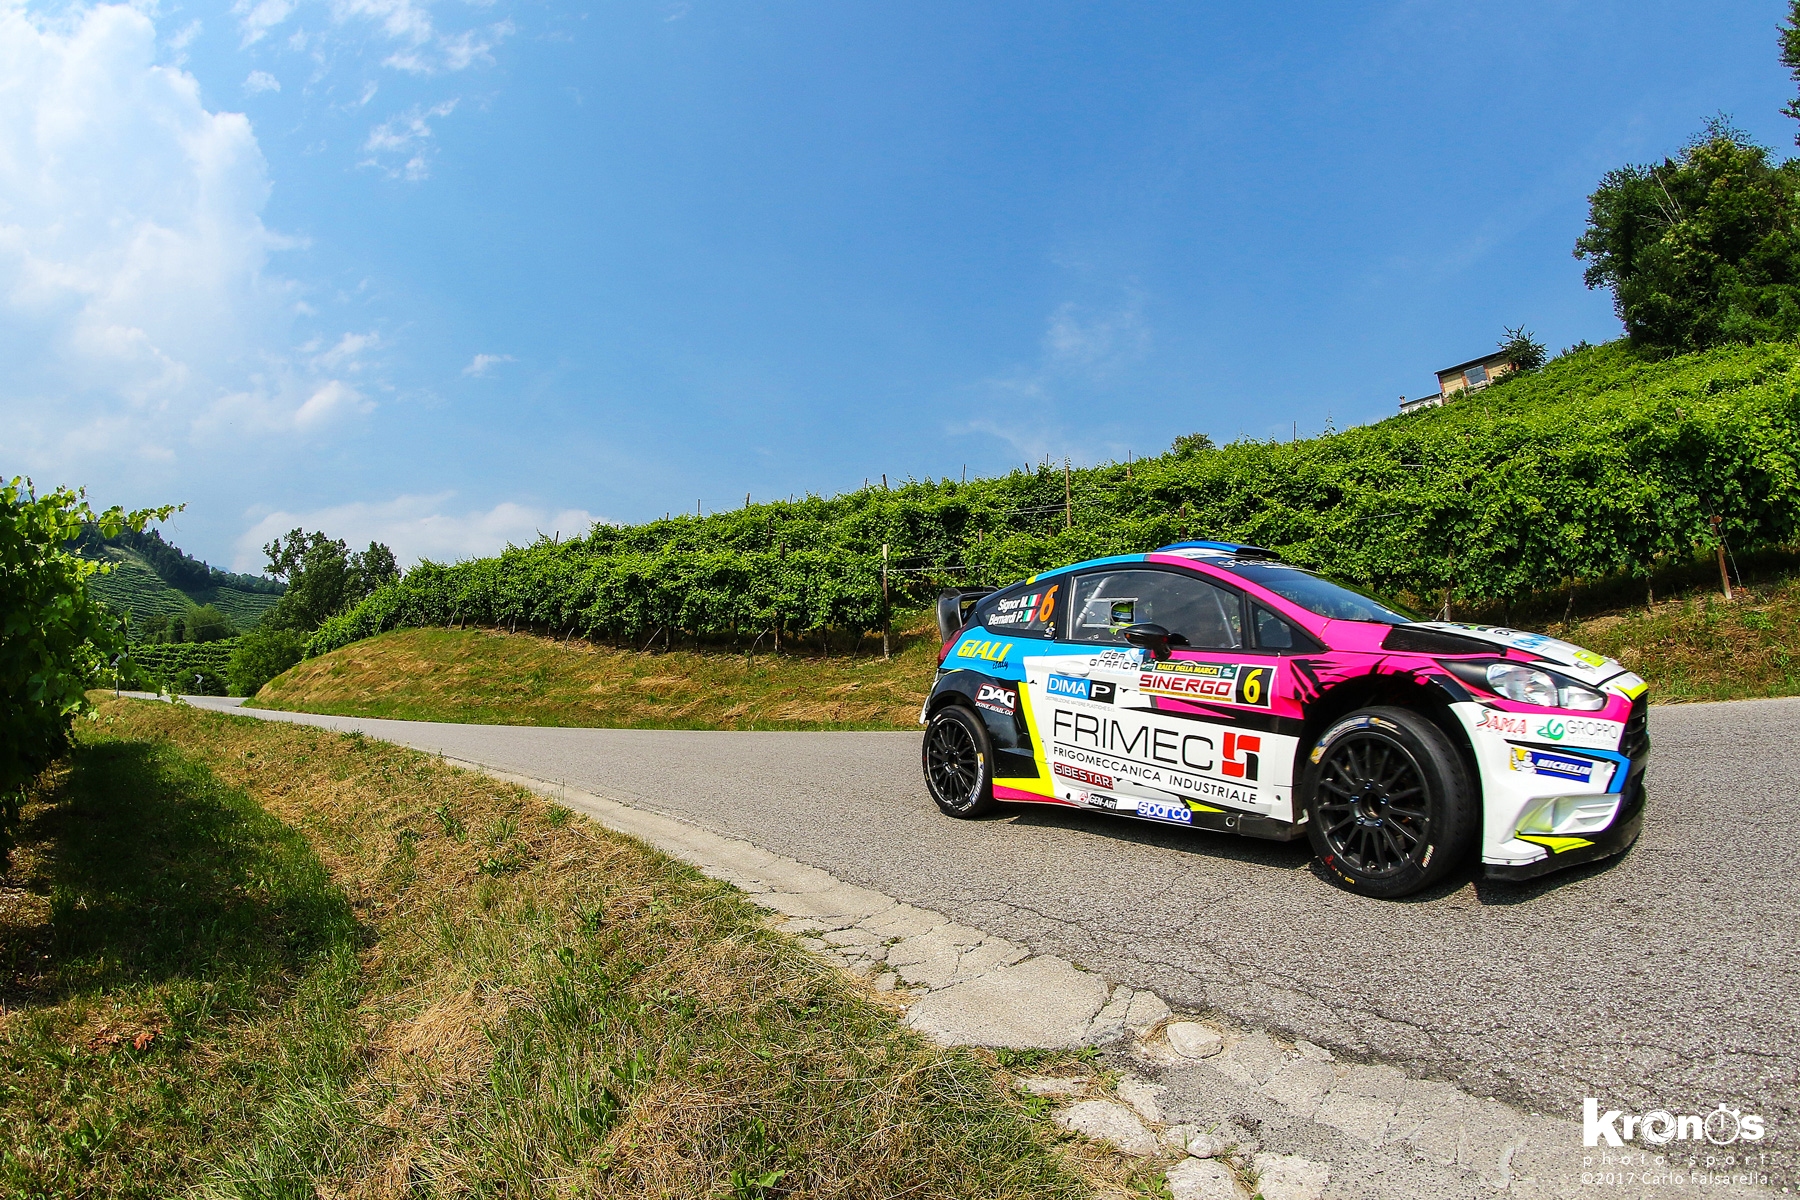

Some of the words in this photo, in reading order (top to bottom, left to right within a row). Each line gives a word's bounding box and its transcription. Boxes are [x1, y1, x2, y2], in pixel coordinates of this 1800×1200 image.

[998, 599, 1020, 613] Signor
[1039, 584, 1060, 622] 6
[988, 611, 1017, 626] Bernardi
[957, 640, 1014, 662] GIALI
[1157, 663, 1175, 671] RALLY
[1175, 665, 1193, 673] DELLA
[1194, 667, 1218, 675] MARCA
[1048, 677, 1088, 696] DIMA
[1090, 683, 1111, 698] P
[1139, 674, 1232, 696] SINERGO
[1243, 668, 1263, 704] 6
[977, 684, 1016, 709] DAG
[1476, 709, 1527, 734] SAMA
[1566, 719, 1619, 739] GROPPO
[1053, 708, 1214, 771] FRIMEC
[1053, 746, 1161, 782] FRIGOMECCANICA
[1169, 774, 1258, 805] INDUSTRIALE
[1054, 763, 1110, 787] SIBESTAR
[1536, 758, 1592, 775] MICHELIN
[1138, 801, 1191, 821] sparco
